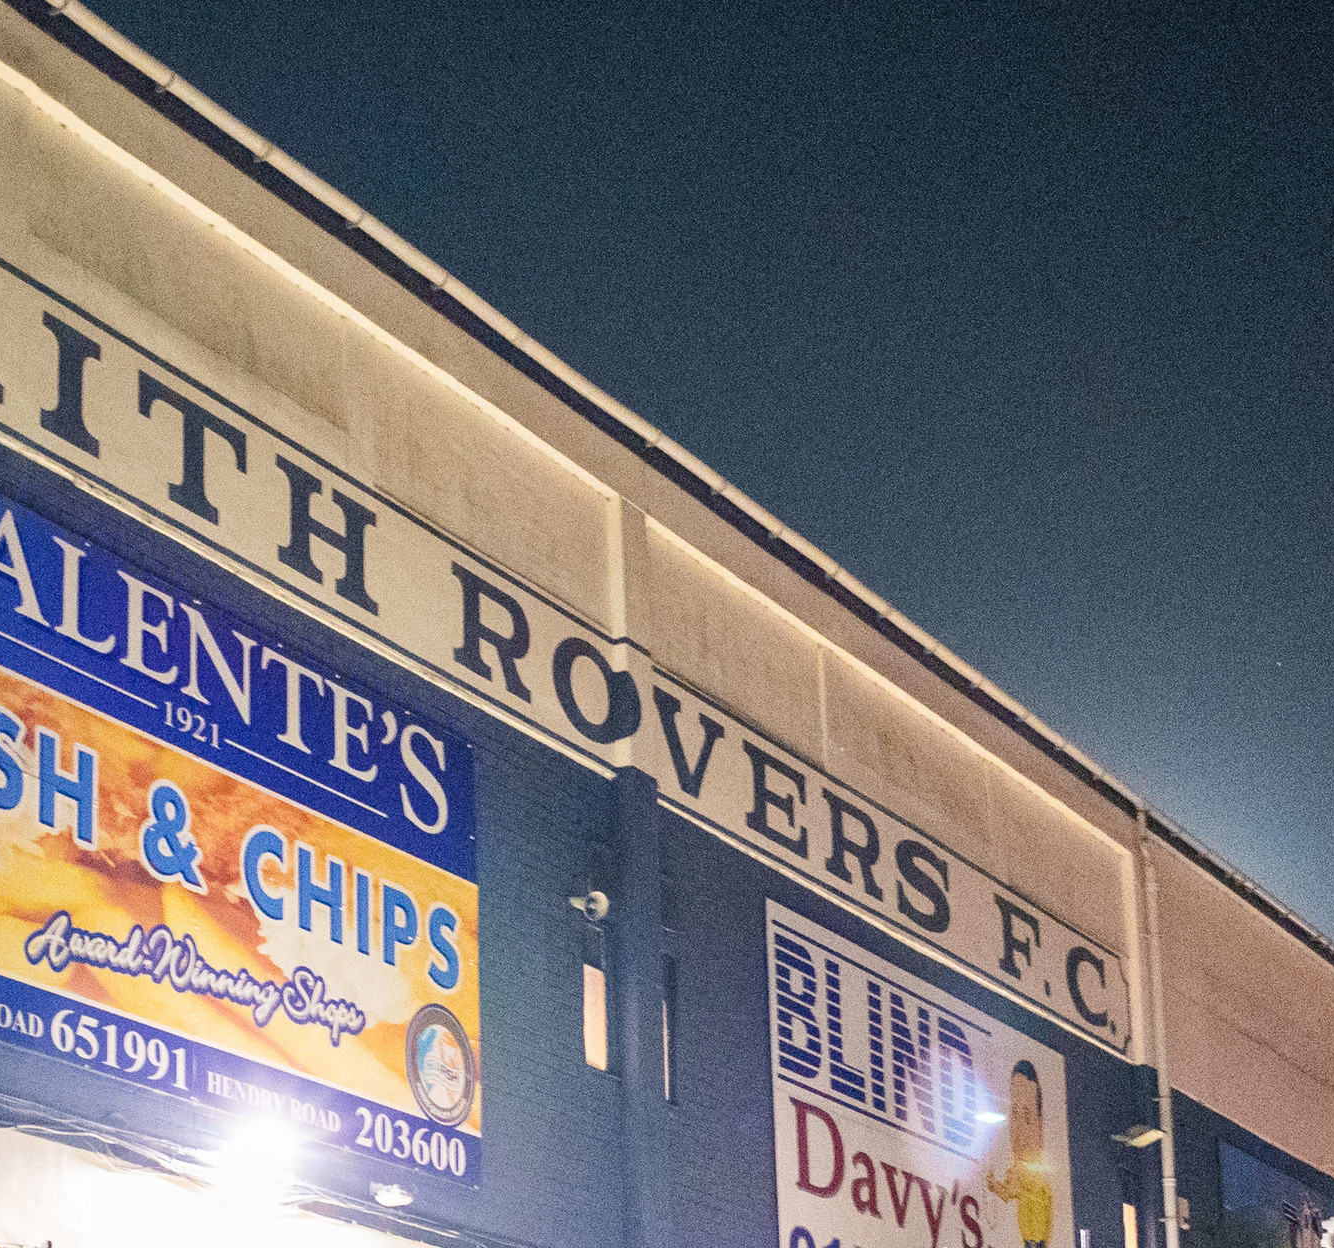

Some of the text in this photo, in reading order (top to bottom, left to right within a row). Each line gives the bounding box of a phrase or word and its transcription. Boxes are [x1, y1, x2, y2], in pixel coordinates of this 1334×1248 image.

[163, 702, 221, 750] 1921
[451, 561, 953, 934] ROVERS
[993, 892, 1117, 1035] F.C.
[140, 777, 208, 895] &
[240, 825, 463, 993] CHIPS
[25, 909, 366, 1047] Award-Winning Shops
[773, 932, 976, 1148] BLIND
[49, 1008, 190, 1092] 651991
[289, 1098, 341, 1133] ROAD
[353, 1106, 467, 1178] 203600
